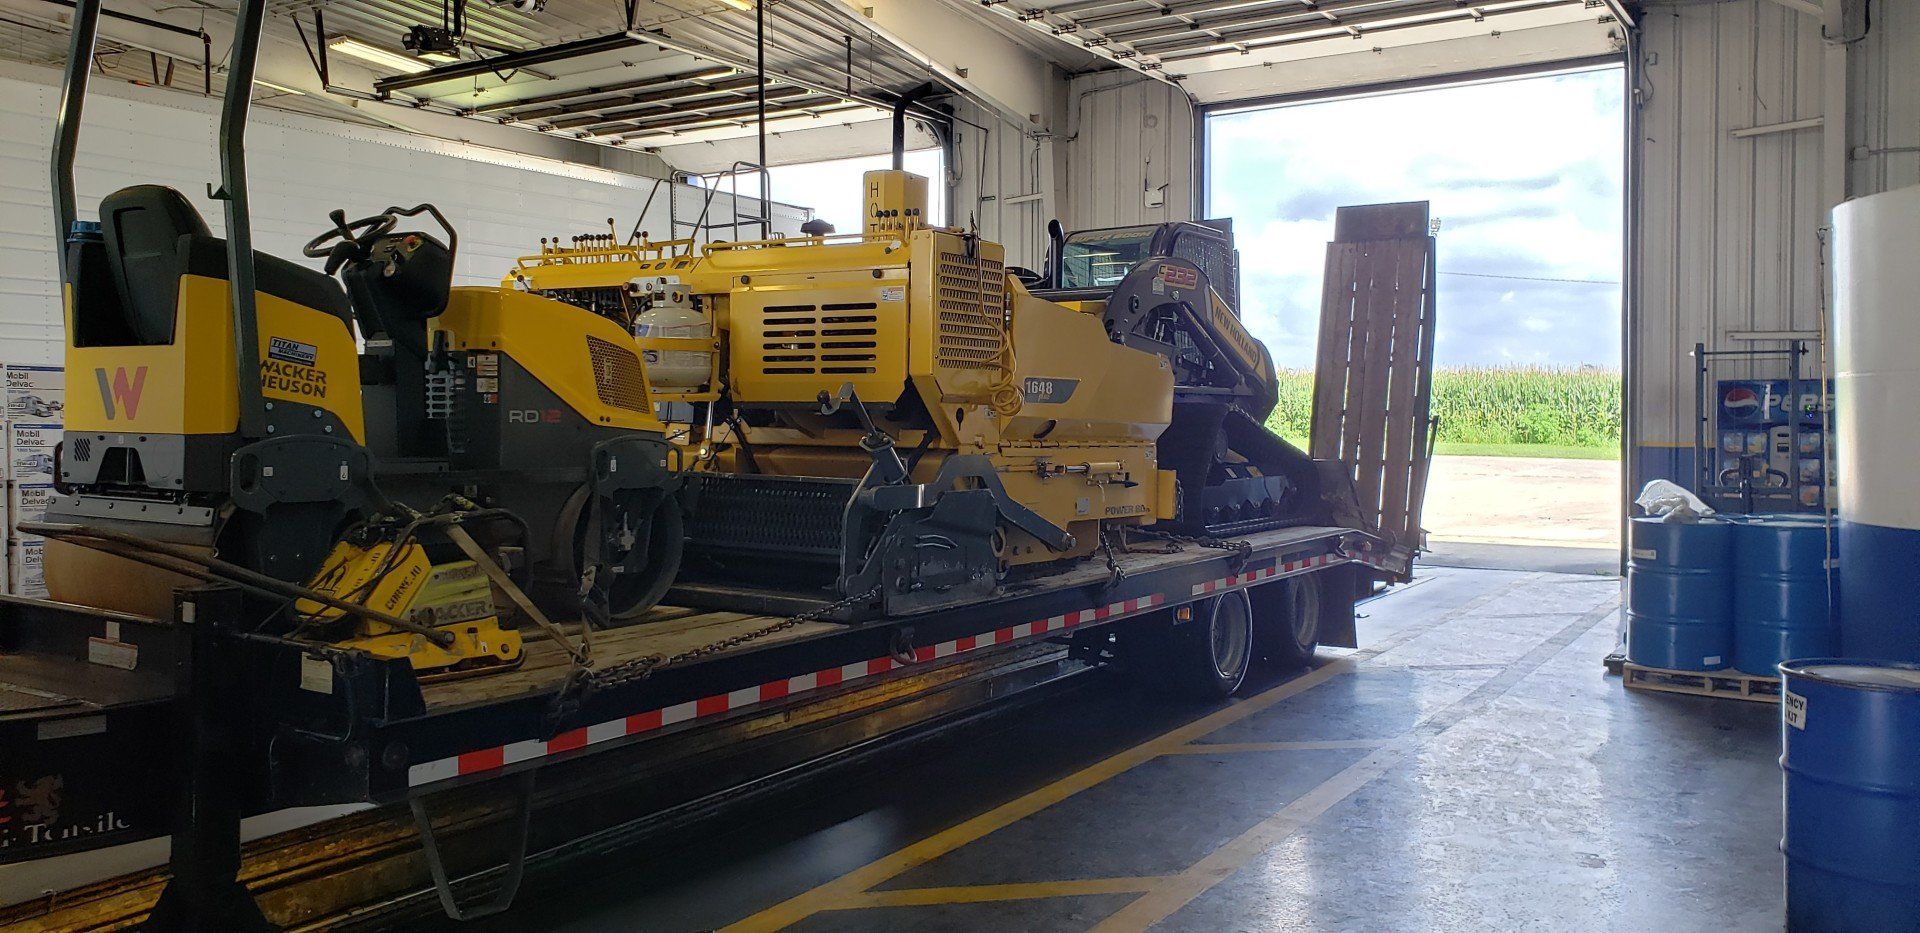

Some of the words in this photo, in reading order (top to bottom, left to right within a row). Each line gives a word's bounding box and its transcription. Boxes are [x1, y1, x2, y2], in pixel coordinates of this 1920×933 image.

[1215, 306, 1231, 330] NEW
[1230, 324, 1257, 364] HOLLAND
[273, 338, 299, 350] TITAN
[6, 371, 29, 380] Mobil
[6, 379, 35, 388] Delvac
[1025, 380, 1053, 394] 1648
[17, 430, 40, 438] Mobil
[16, 438, 45, 446] Delvac
[22, 489, 46, 497] Mobil
[1105, 504, 1134, 516] POWER
[25, 548, 44, 556] Mob
[25, 556, 43, 564] Delv
